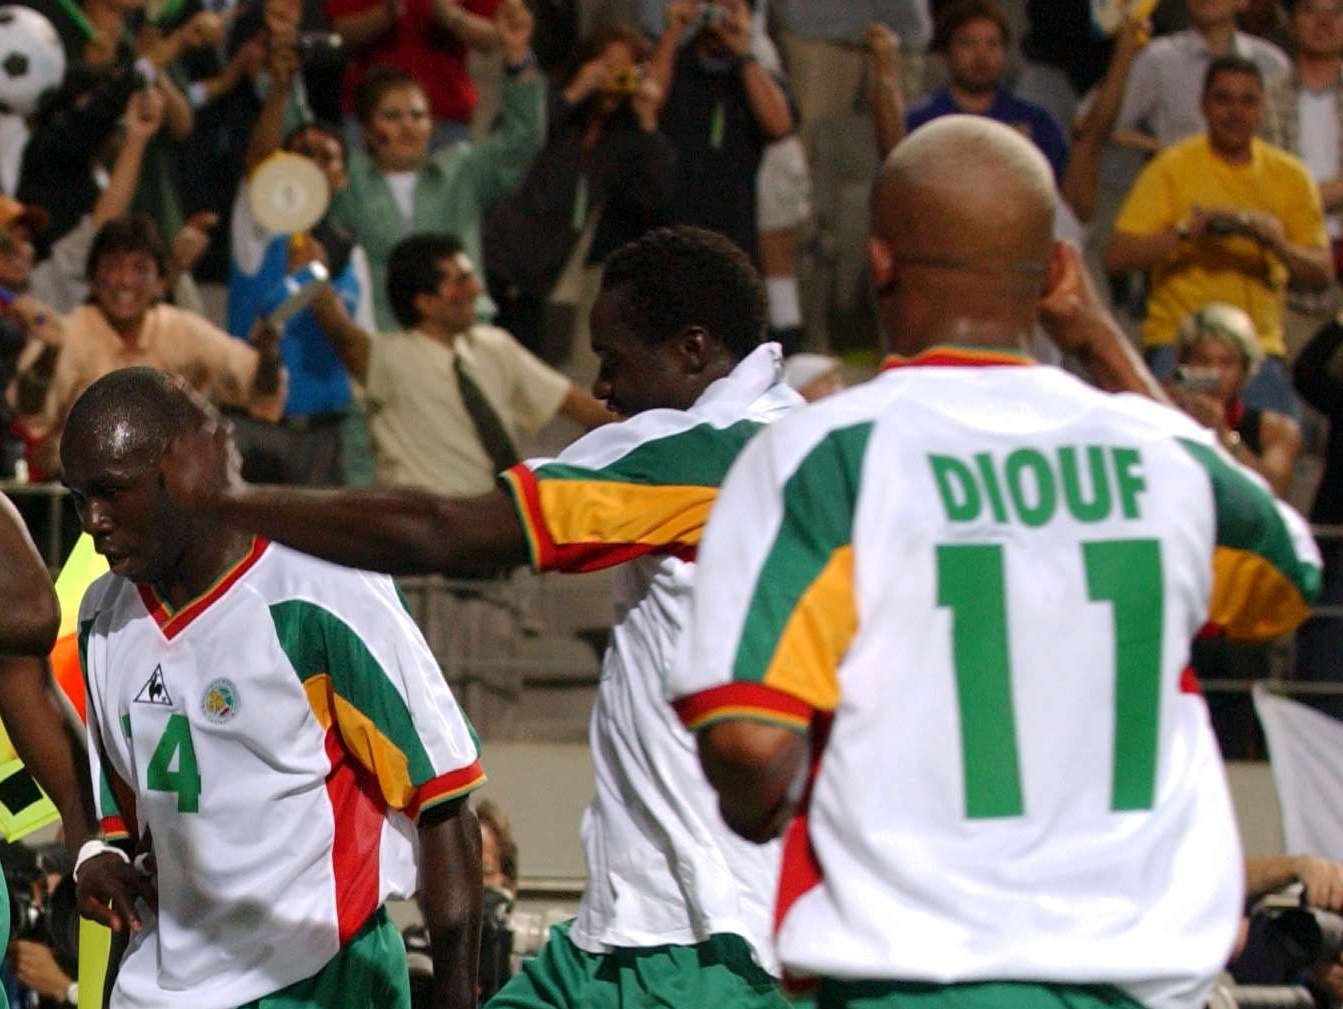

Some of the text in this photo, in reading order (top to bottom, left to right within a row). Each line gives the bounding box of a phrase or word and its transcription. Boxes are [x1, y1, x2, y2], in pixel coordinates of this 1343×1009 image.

[929, 447, 1146, 526] DIOUF
[937, 538, 1164, 819] 11
[122, 712, 201, 814] 4
